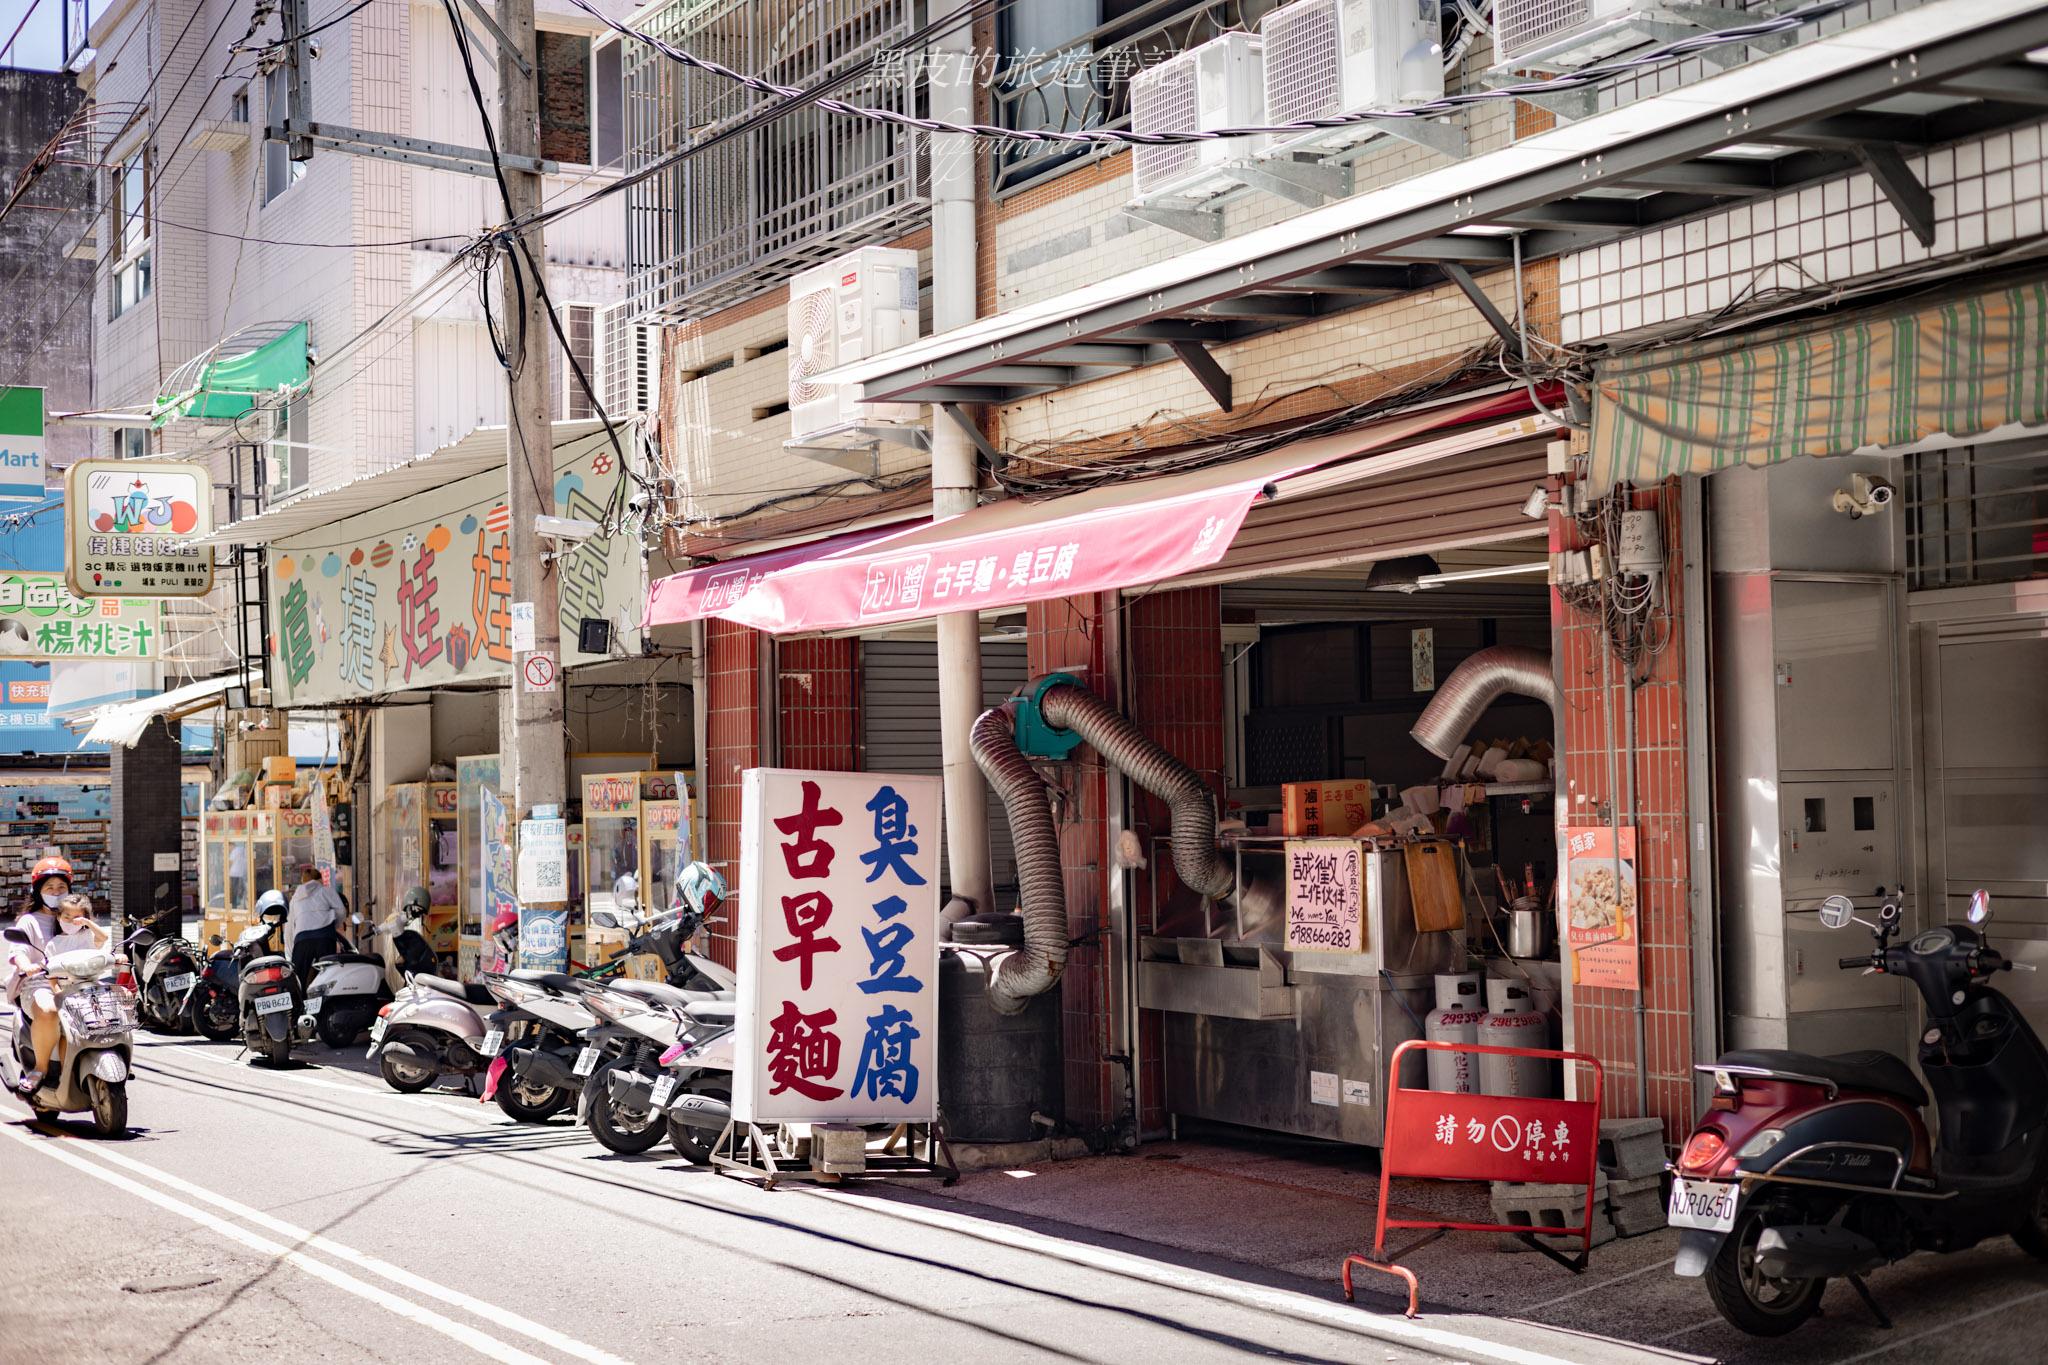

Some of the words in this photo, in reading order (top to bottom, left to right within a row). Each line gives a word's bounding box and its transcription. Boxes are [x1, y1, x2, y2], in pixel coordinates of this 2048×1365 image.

[85, 562, 102, 572] 3C
[105, 562, 127, 573] 精品
[161, 578, 179, 586] PULI
[36, 620, 153, 656] 楊桃汁
[589, 783, 605, 801] TOY
[607, 781, 634, 802] STORY
[1293, 852, 1344, 888] 誠徵
[1297, 884, 1347, 911] 工作伙伴
[1291, 905, 1304, 921] We
[1307, 911, 1325, 921] want
[1325, 907, 1338, 923] You
[766, 780, 844, 1102] 古早麵
[851, 785, 927, 1105] 臭豆腐
[1290, 925, 1352, 949] 0988660283
[1522, 1150, 1570, 1163] 謝謝合作
